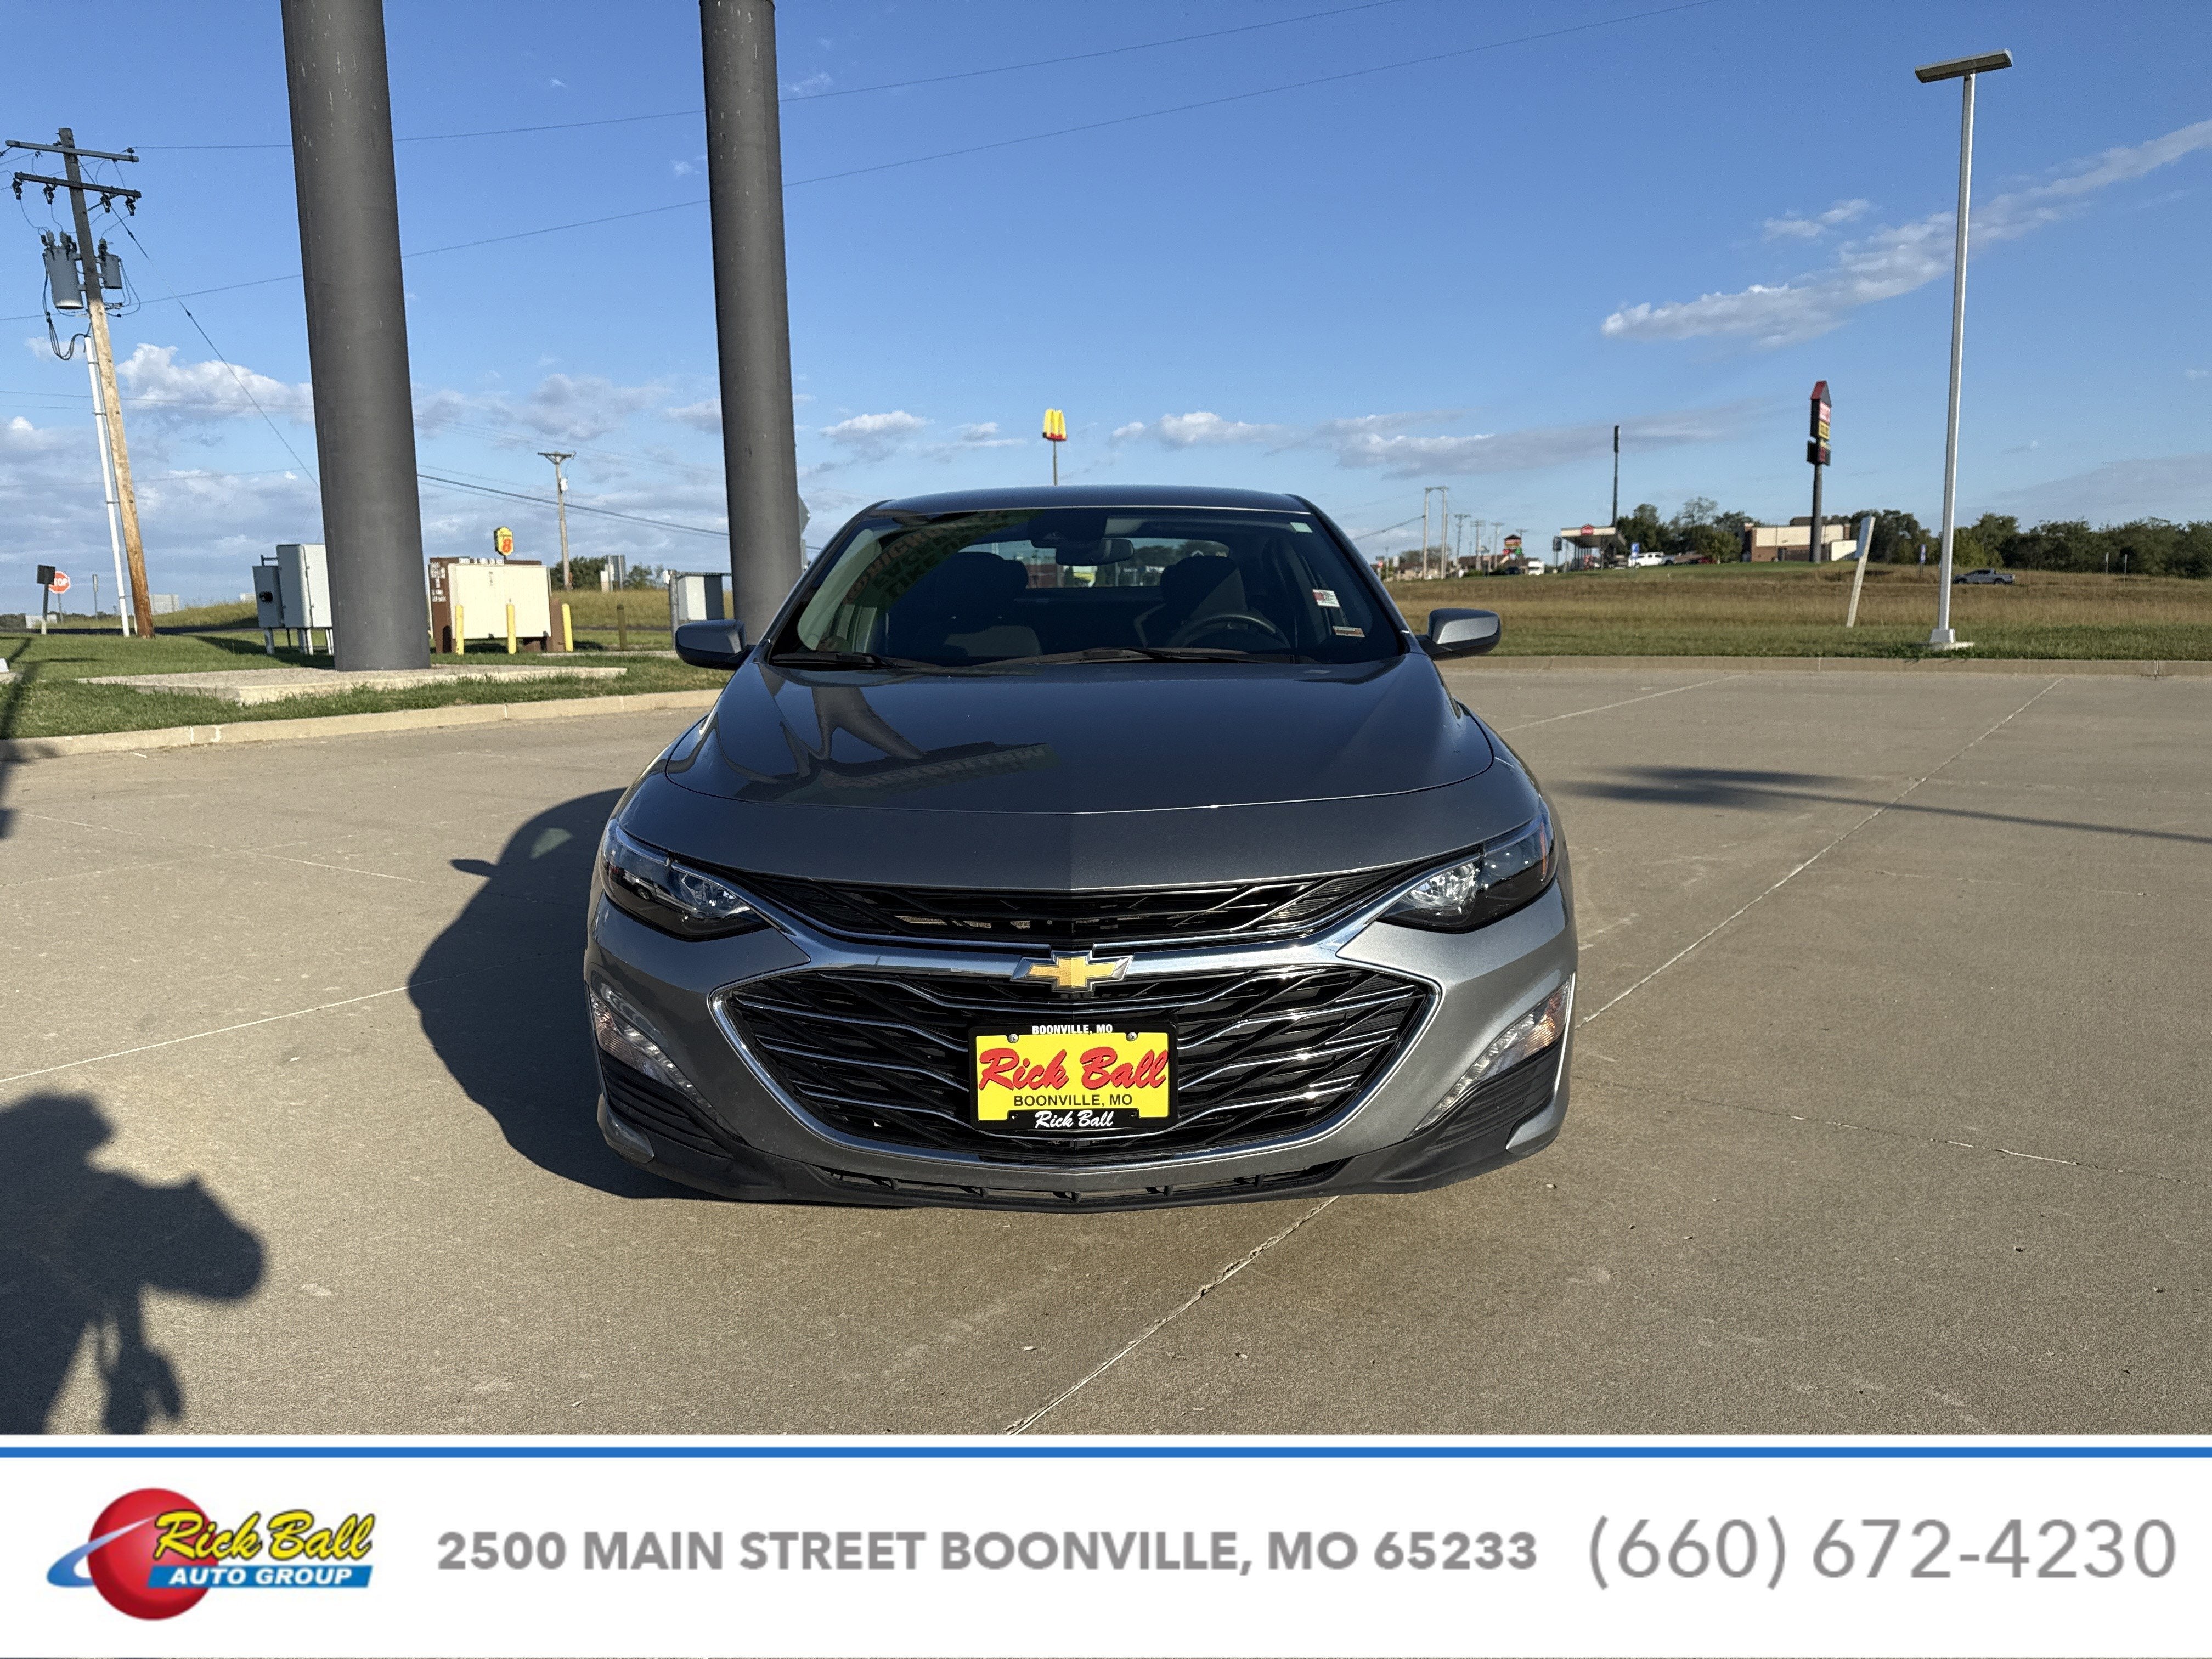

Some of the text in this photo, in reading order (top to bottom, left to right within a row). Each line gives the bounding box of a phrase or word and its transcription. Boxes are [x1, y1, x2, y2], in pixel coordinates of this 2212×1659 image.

[502, 538, 512, 553] 8
[1032, 1024, 1113, 1035] BOONVILLE, MO
[979, 1046, 1169, 1091] Rick Ball
[1013, 1094, 1133, 1108] BOONVILLE, MO
[1035, 1109, 1114, 1128] Rick Ball
